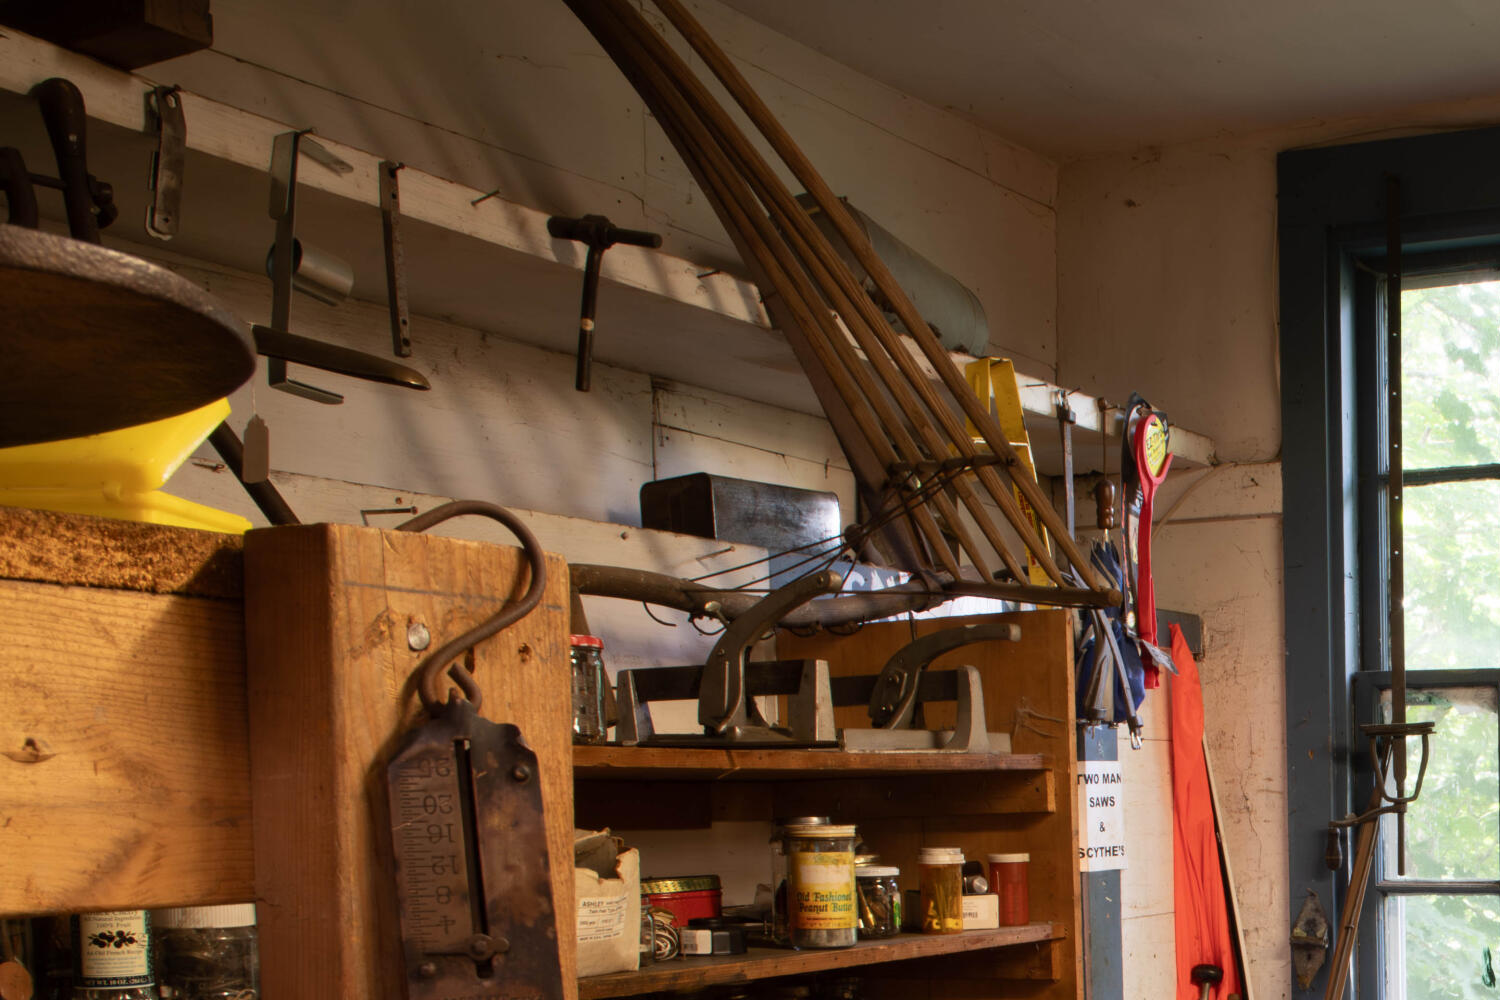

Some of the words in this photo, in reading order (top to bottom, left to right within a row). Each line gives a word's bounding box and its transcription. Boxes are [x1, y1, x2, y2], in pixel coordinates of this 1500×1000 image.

[1077, 774, 1099, 785] TWO
[1102, 773, 1122, 784] MAN
[424, 795, 452, 814] 20
[1089, 796, 1115, 807] SAWS
[426, 824, 455, 844] 16
[1100, 821, 1105, 832] &
[1078, 845, 1125, 859] SCYTHE'S
[431, 856, 459, 875] 12
[435, 886, 450, 904] 8
[440, 915, 455, 934] 4
